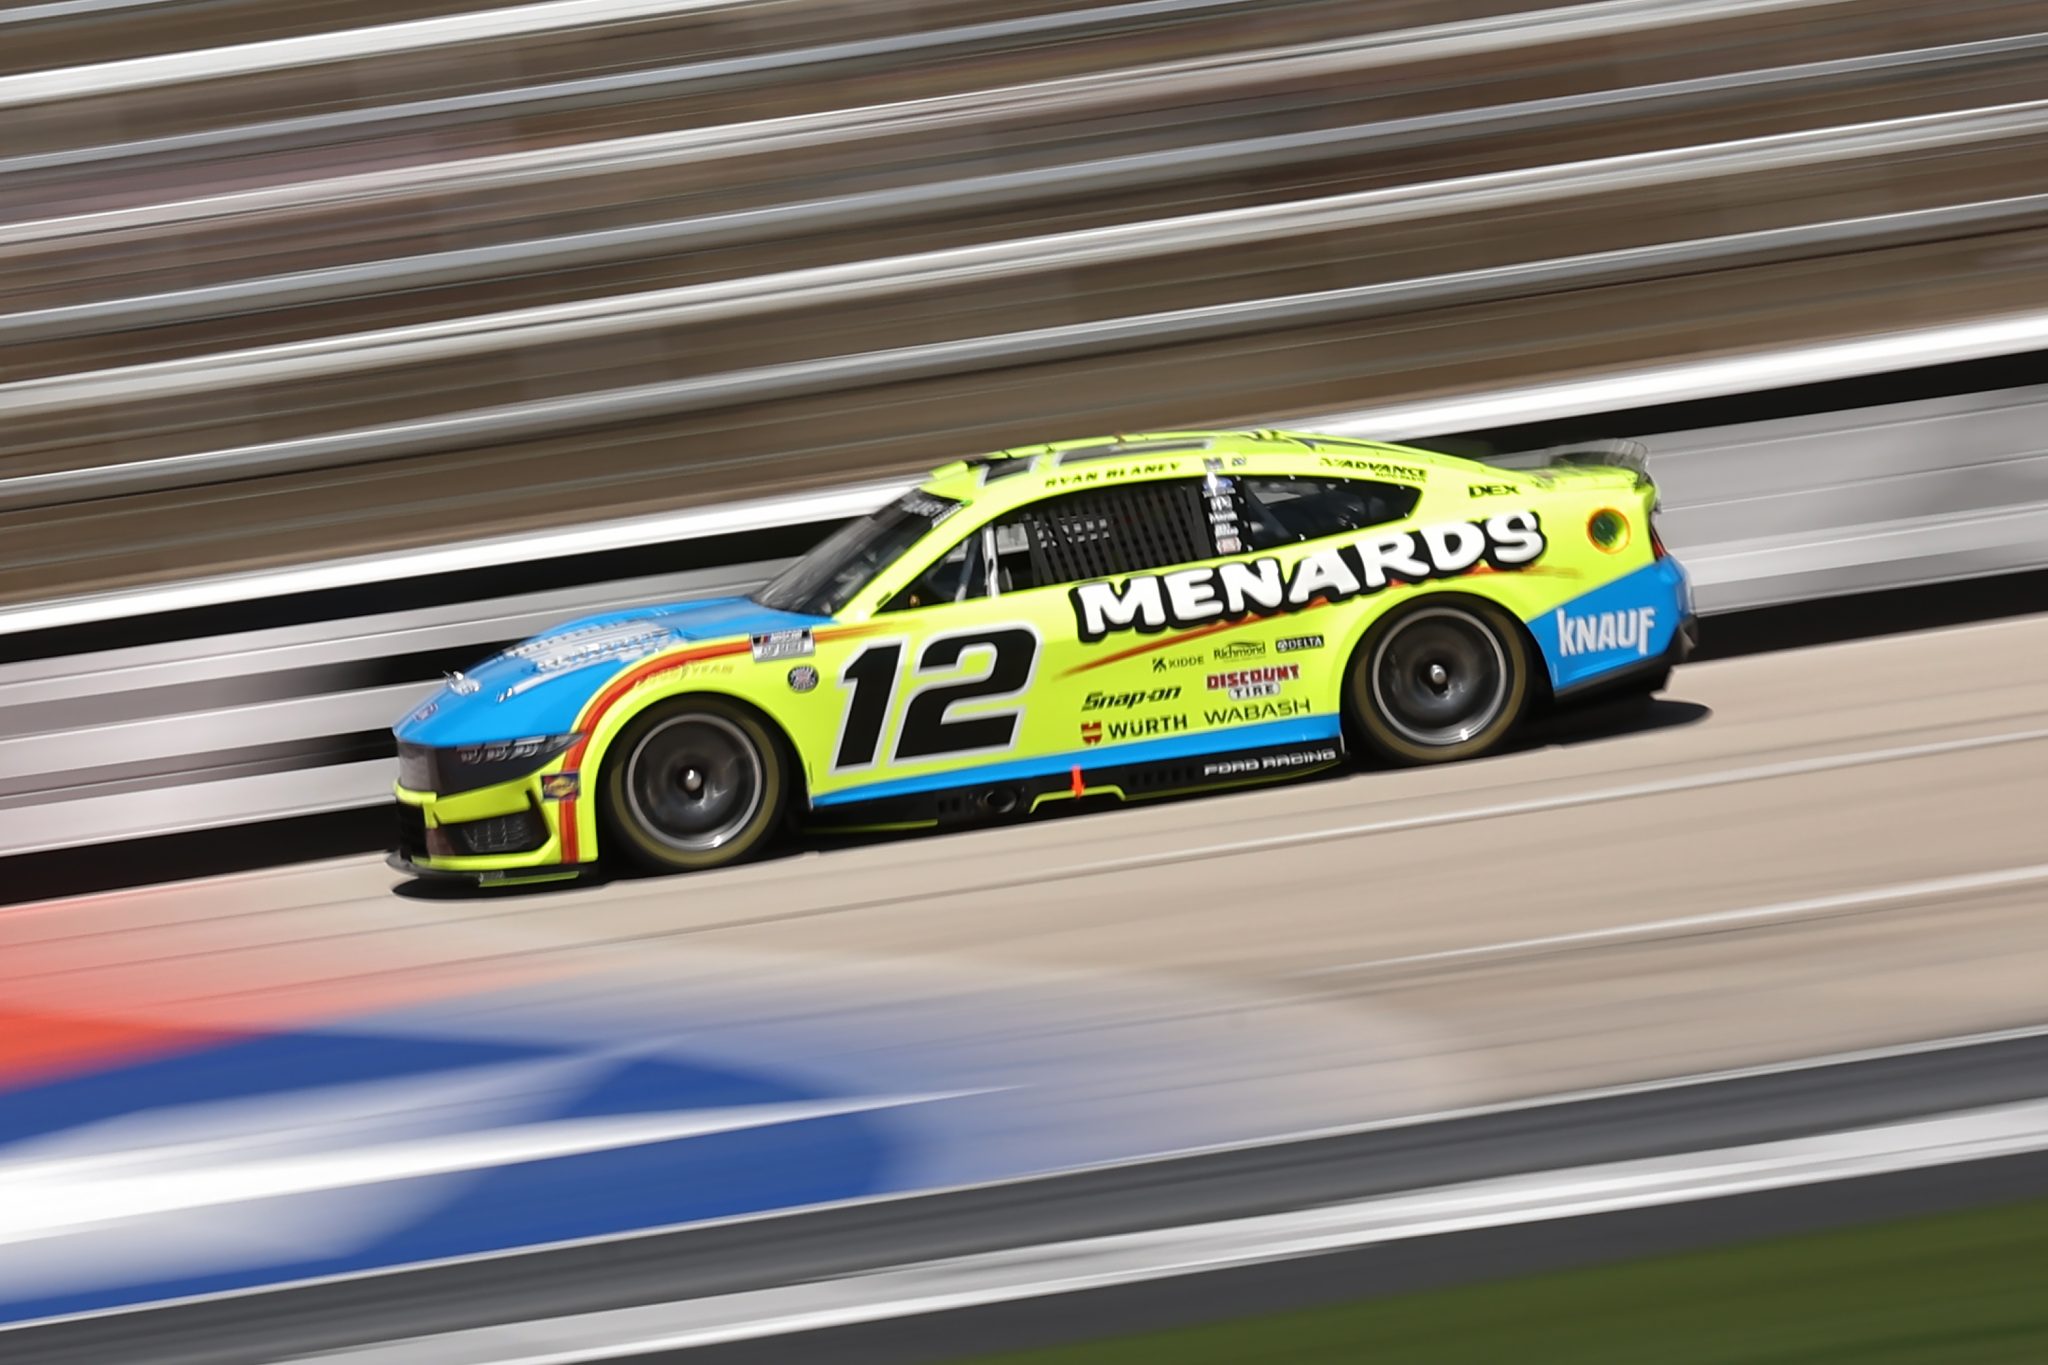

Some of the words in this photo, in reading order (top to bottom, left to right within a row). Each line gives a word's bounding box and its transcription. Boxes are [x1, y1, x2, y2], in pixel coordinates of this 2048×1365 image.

[1341, 459, 1427, 477] ADVANCE
[1468, 485, 1520, 499] DEX
[1070, 510, 1547, 640] MENARDS
[1213, 641, 1266, 660] Richmond
[1288, 636, 1323, 650] DELTA
[1169, 656, 1204, 668] KIDDE
[1206, 664, 1300, 690] DISCOUNT
[831, 622, 1042, 775] 12
[1081, 685, 1182, 711] Snap-on
[1234, 684, 1275, 699] TIRE
[1204, 697, 1311, 726] WABASH
[1204, 758, 1260, 776] FORD
[1262, 748, 1336, 769] RACING
